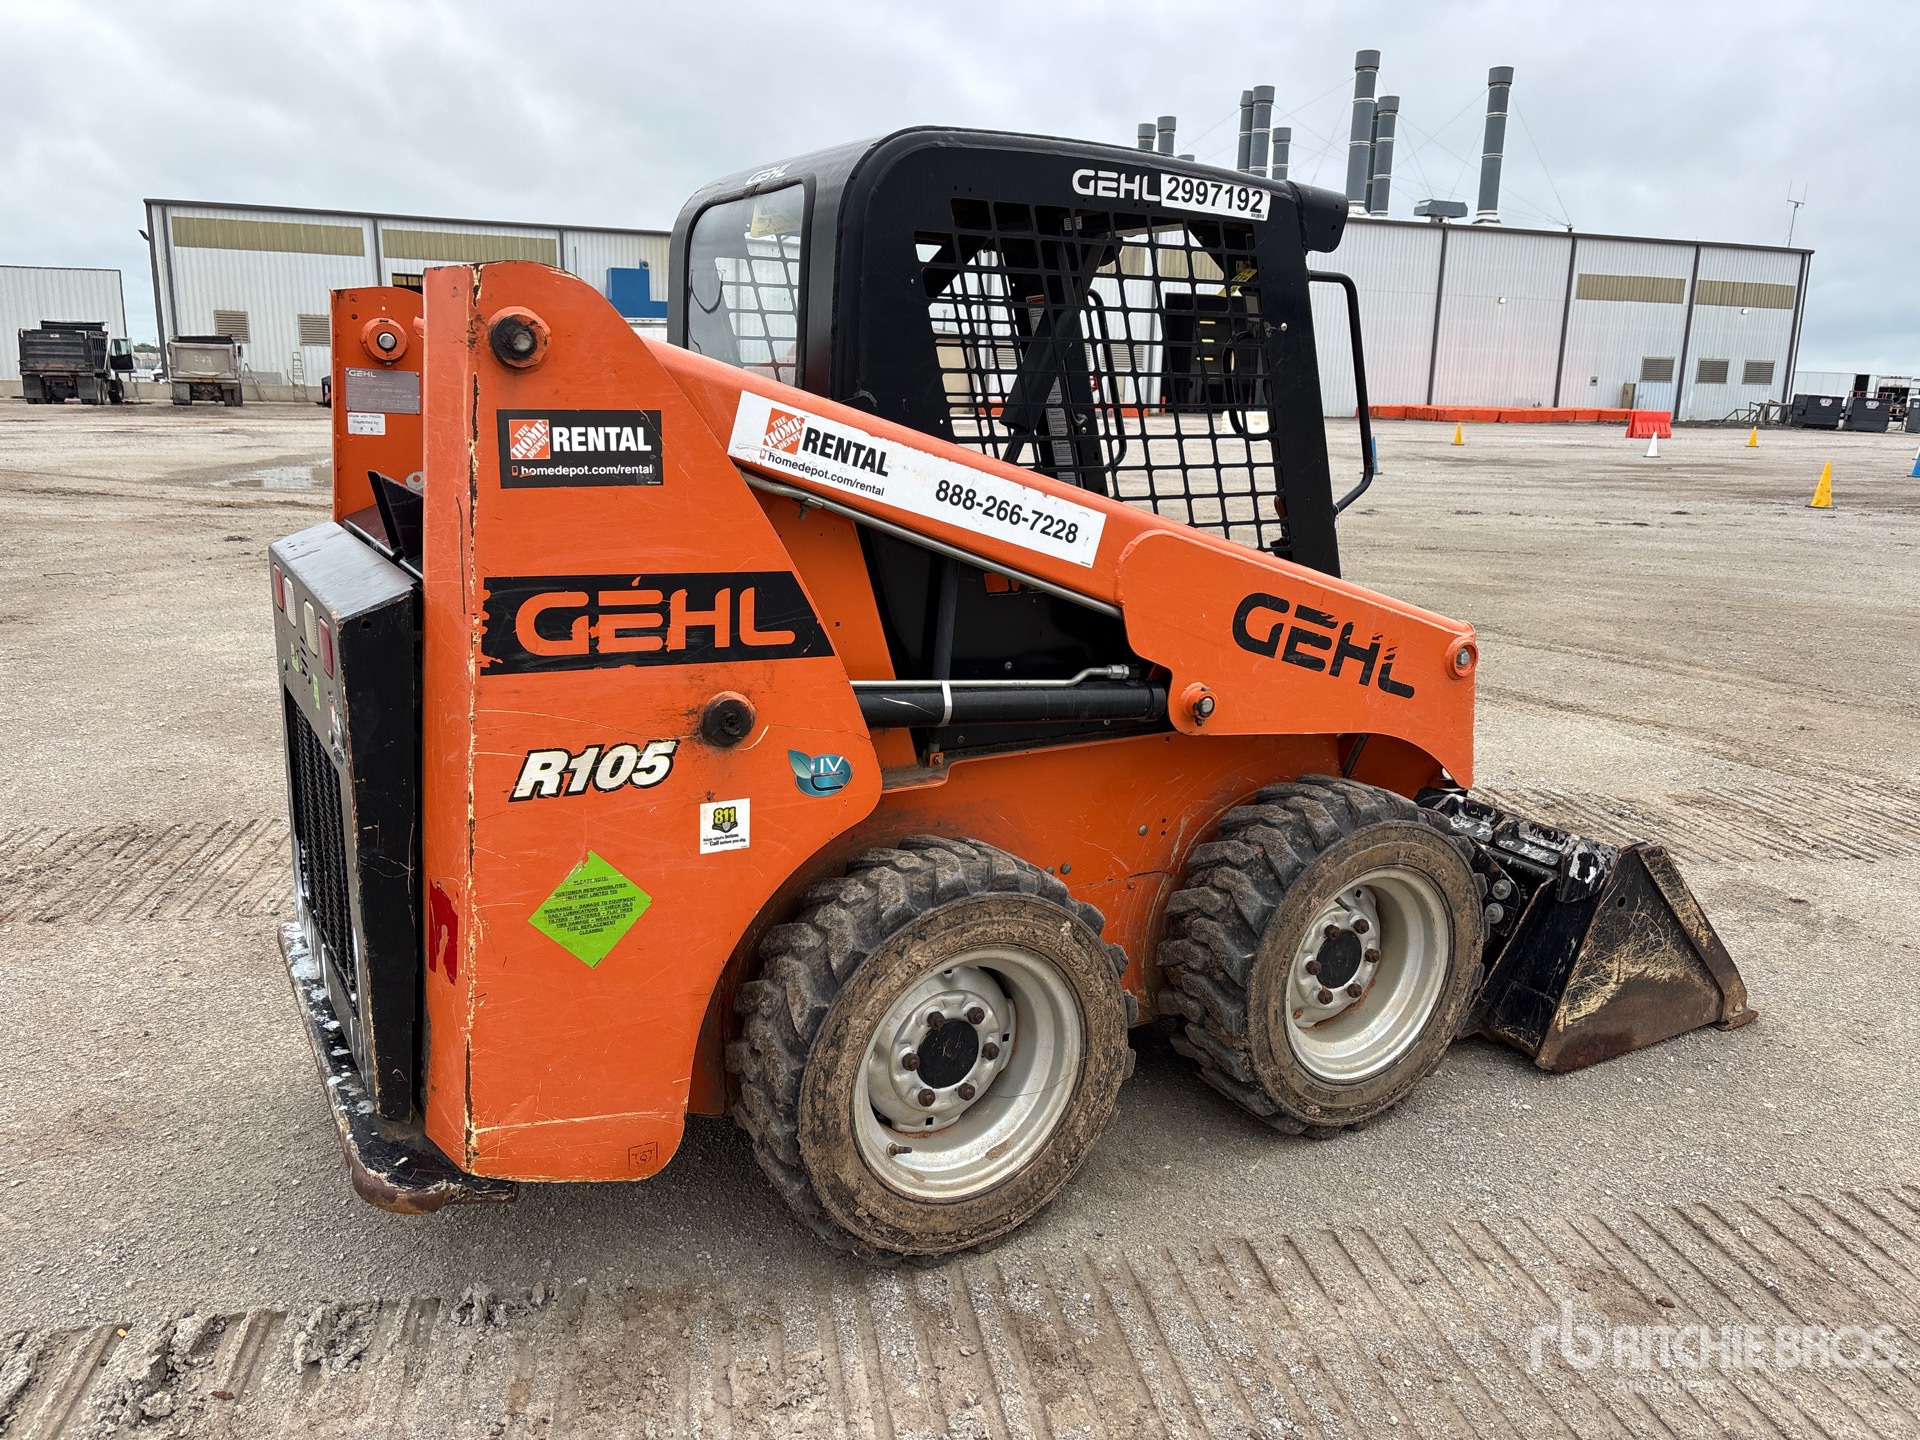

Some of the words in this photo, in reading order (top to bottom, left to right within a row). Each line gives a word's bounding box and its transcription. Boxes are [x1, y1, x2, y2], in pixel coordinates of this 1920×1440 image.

[1072, 168, 1160, 202] GEHL
[1166, 177, 1264, 213] 2997192
[348, 369, 377, 378] GEHL
[514, 424, 530, 440] THE
[764, 416, 805, 447] HOME
[771, 415, 787, 429] THE
[511, 420, 549, 459] HOME
[527, 434, 549, 459] DEPOT
[552, 426, 652, 452] RENTAL
[777, 430, 802, 450] DEPOT
[802, 427, 889, 477] RENTAL
[520, 464, 653, 477] homedepot.com/rental
[768, 452, 885, 496] homedepot.com/rental
[935, 480, 1079, 543] 888-266-7228
[515, 587, 796, 657] GEHL
[1232, 592, 1415, 699] GEHL
[508, 739, 680, 803] R105
[713, 806, 736, 825] 811
[555, 889, 583, 897] CUSTOMER
[583, 883, 628, 893] RESPONSIBILITIES
[544, 905, 573, 914] INSURANCE
[608, 896, 636, 904] EQUIPMENT
[563, 907, 598, 917] LUBRICATIONS
[574, 912, 600, 920] BATTERIES
[579, 927, 604, 936] CLEANING
[581, 920, 616, 930] REPLACEMENT
